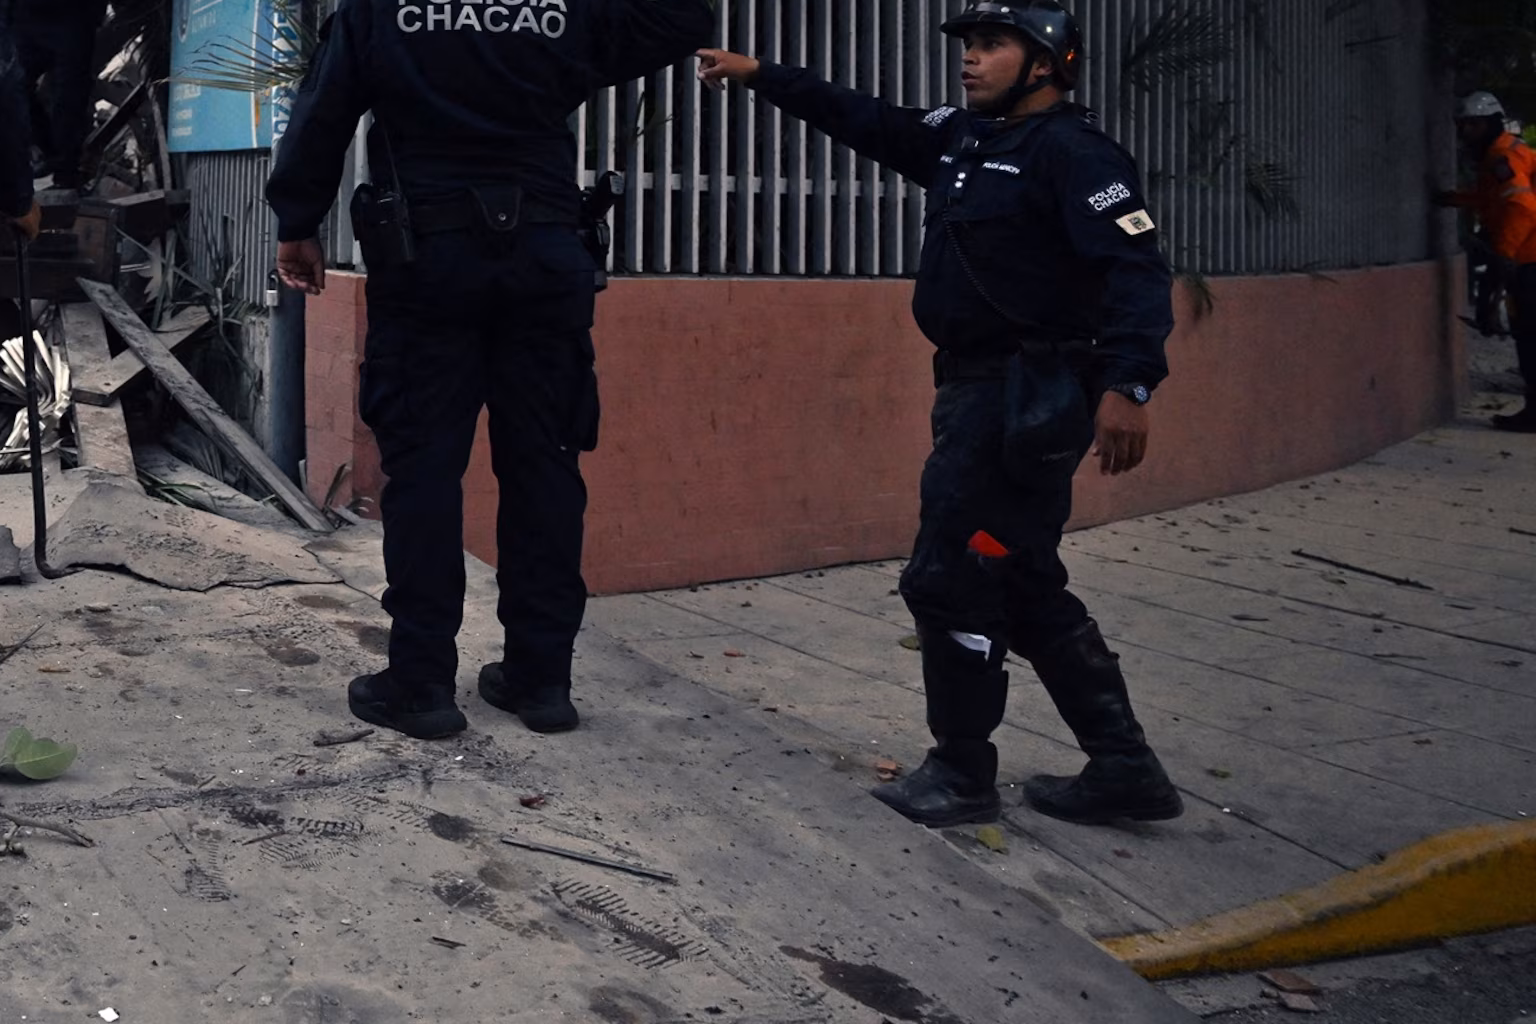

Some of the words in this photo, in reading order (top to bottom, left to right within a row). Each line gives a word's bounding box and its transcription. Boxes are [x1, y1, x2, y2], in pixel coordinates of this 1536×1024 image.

[396, 4, 566, 38] CHACAO
[1088, 182, 1125, 205] POLICÍA
[1094, 189, 1131, 211] CHACAO
